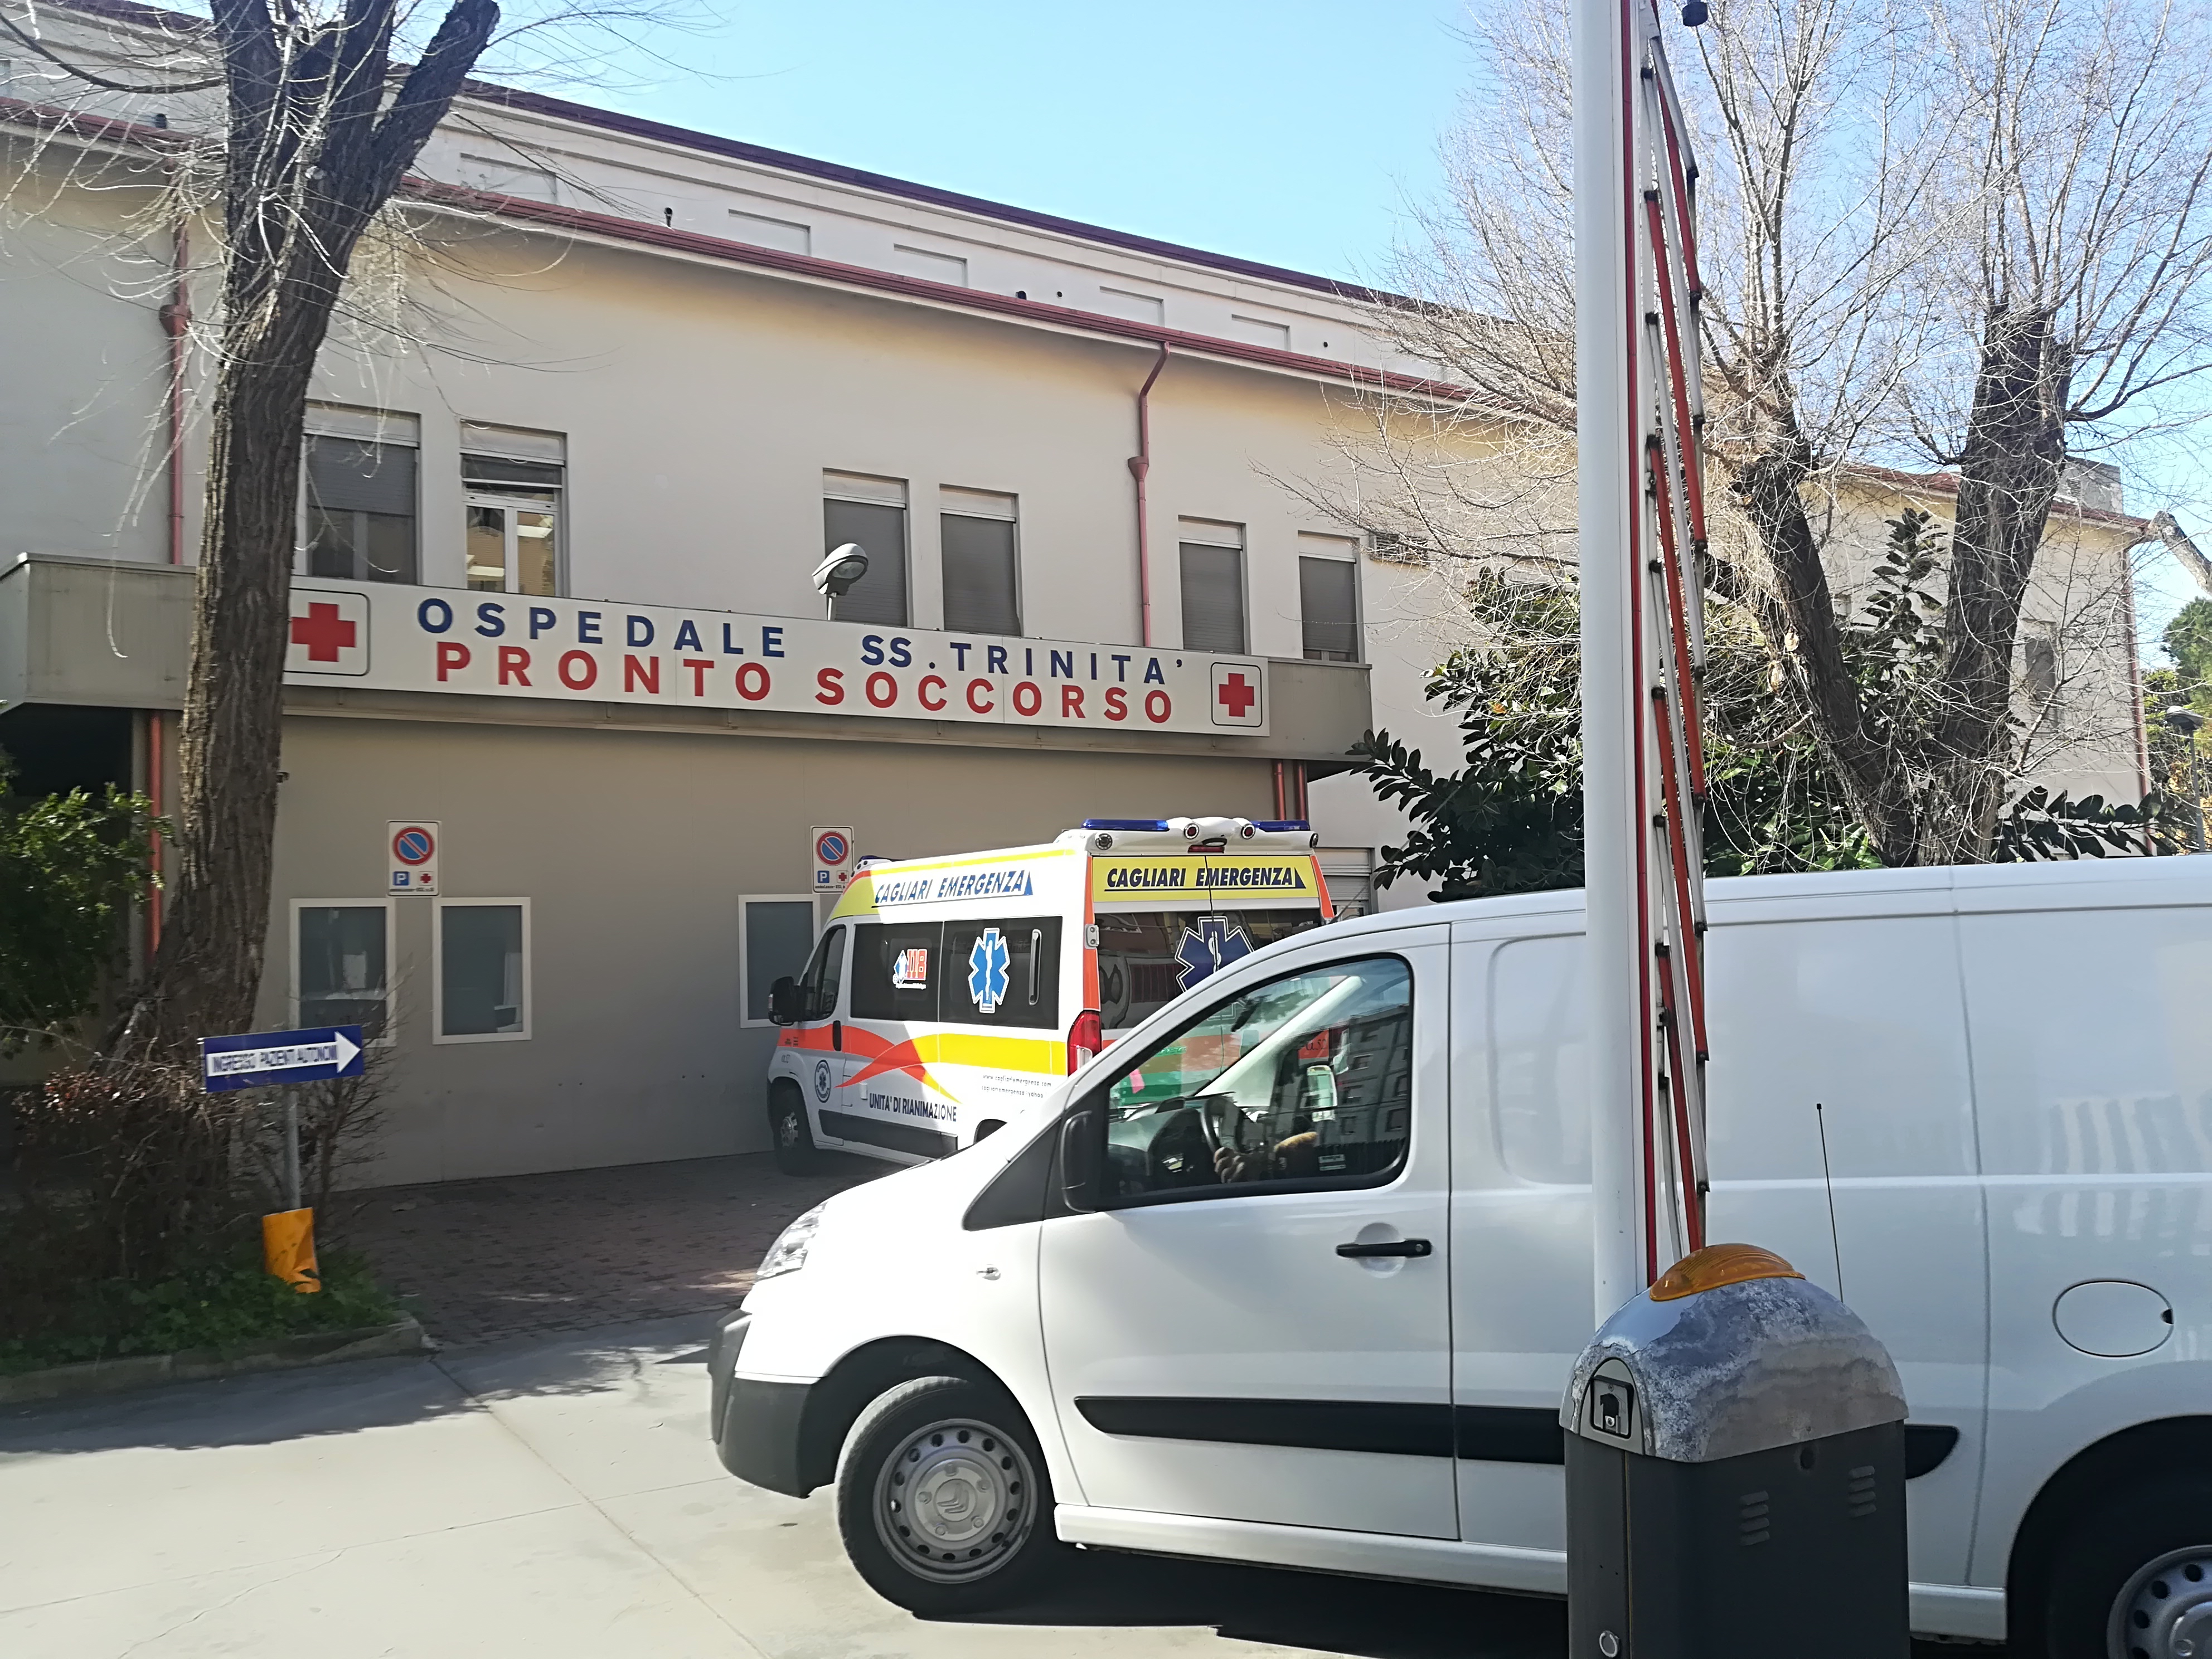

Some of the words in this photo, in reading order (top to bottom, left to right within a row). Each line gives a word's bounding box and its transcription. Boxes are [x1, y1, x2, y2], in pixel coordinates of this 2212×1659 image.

[418, 598, 785, 658] OSPEDALE
[436, 641, 771, 702] PRONTO
[814, 667, 1172, 724] SOCCORSO
[396, 873, 406, 884] P
[820, 872, 828, 882] P
[875, 879, 934, 904] CAGLIARI
[937, 870, 1025, 898] EMERGENZA
[1107, 868, 1186, 887] CAGLIARI
[1195, 867, 1293, 887] EMERGENZA
[870, 1093, 892, 1112] UNITA'
[893, 1097, 901, 1113] DI
[902, 1098, 957, 1122] RIANIMAZIONE
